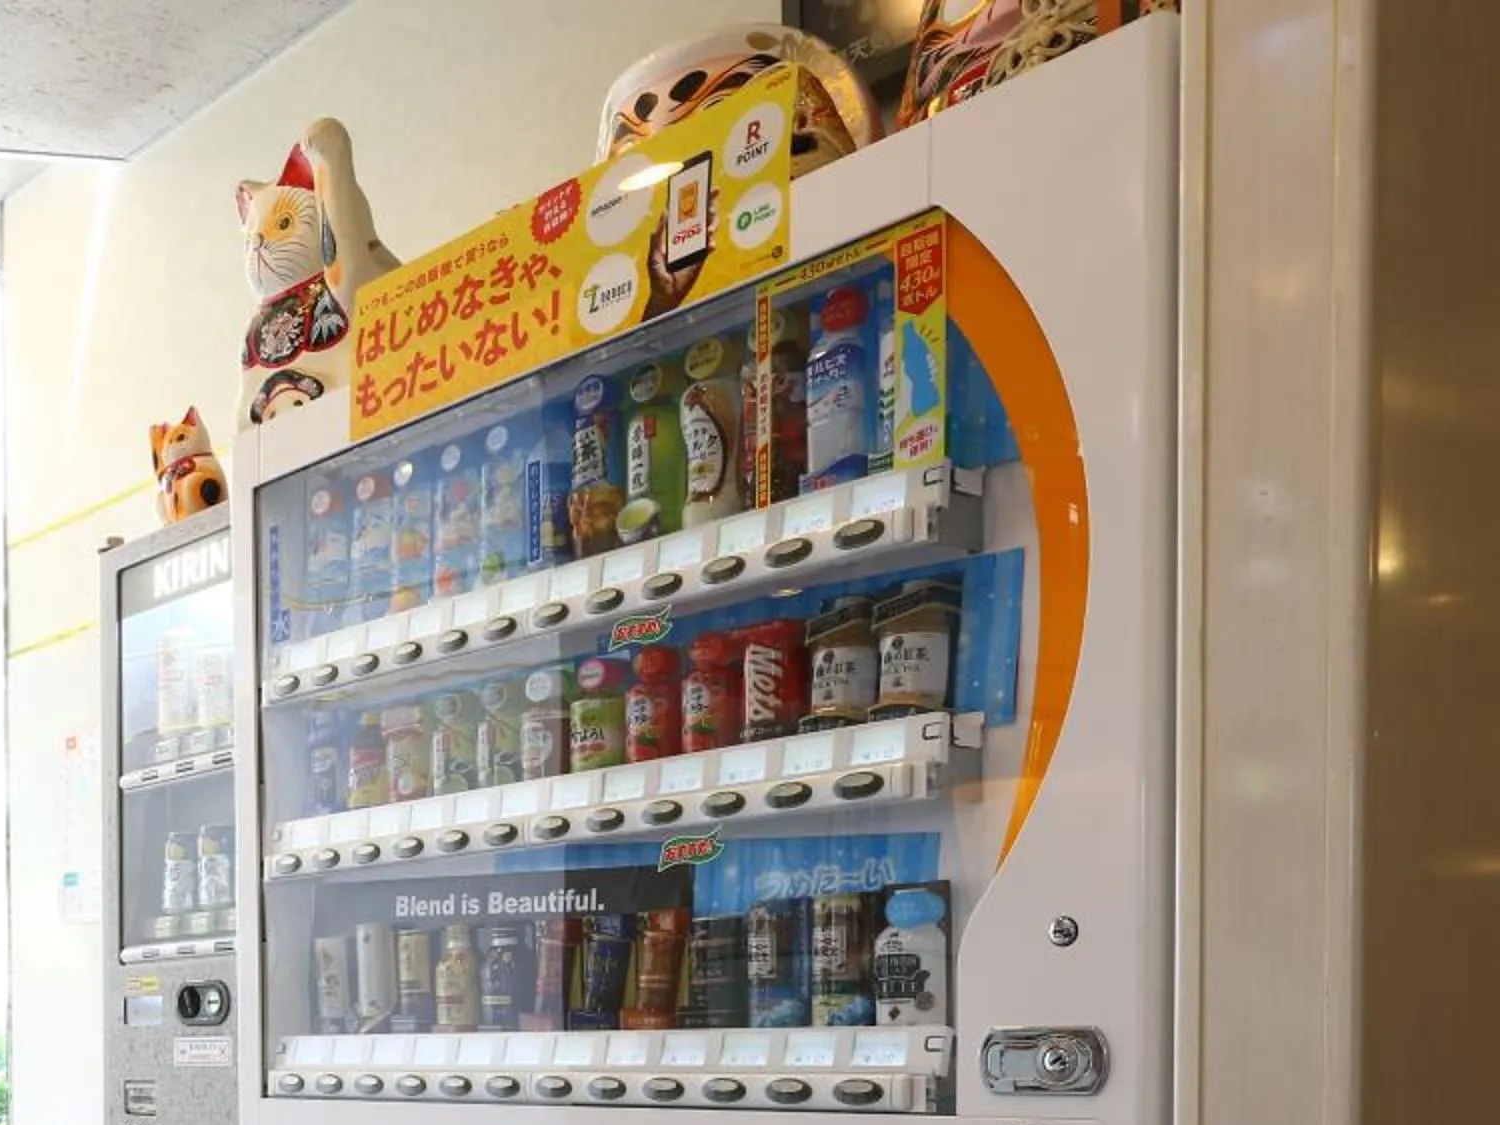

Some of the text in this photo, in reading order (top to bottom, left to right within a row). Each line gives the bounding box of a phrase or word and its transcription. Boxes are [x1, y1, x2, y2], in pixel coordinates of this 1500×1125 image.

[746, 120, 761, 145] R
[735, 142, 770, 167] POINT
[153, 536, 229, 598] KIRIN
[395, 888, 604, 917] Blend is Beautiful.
